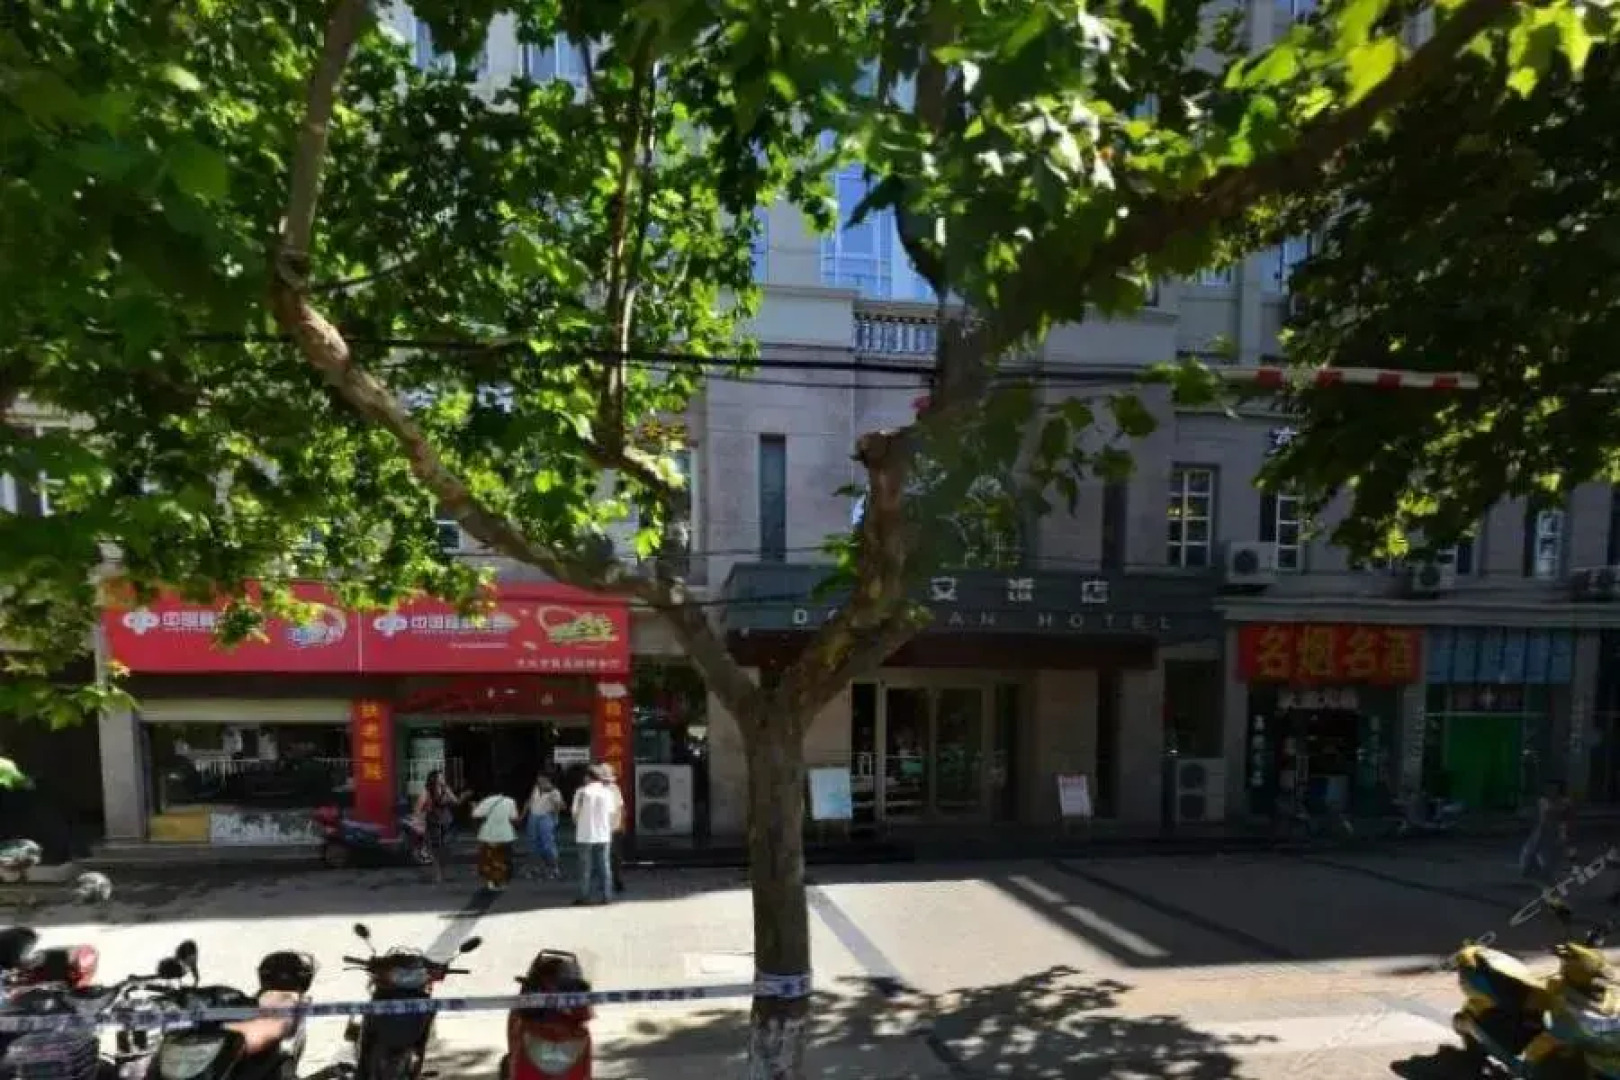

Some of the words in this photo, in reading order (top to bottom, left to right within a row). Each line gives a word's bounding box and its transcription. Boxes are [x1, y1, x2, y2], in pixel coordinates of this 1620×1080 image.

[1037, 612, 1172, 631] HOTEL
[1254, 626, 1416, 680] 名烟名酒
